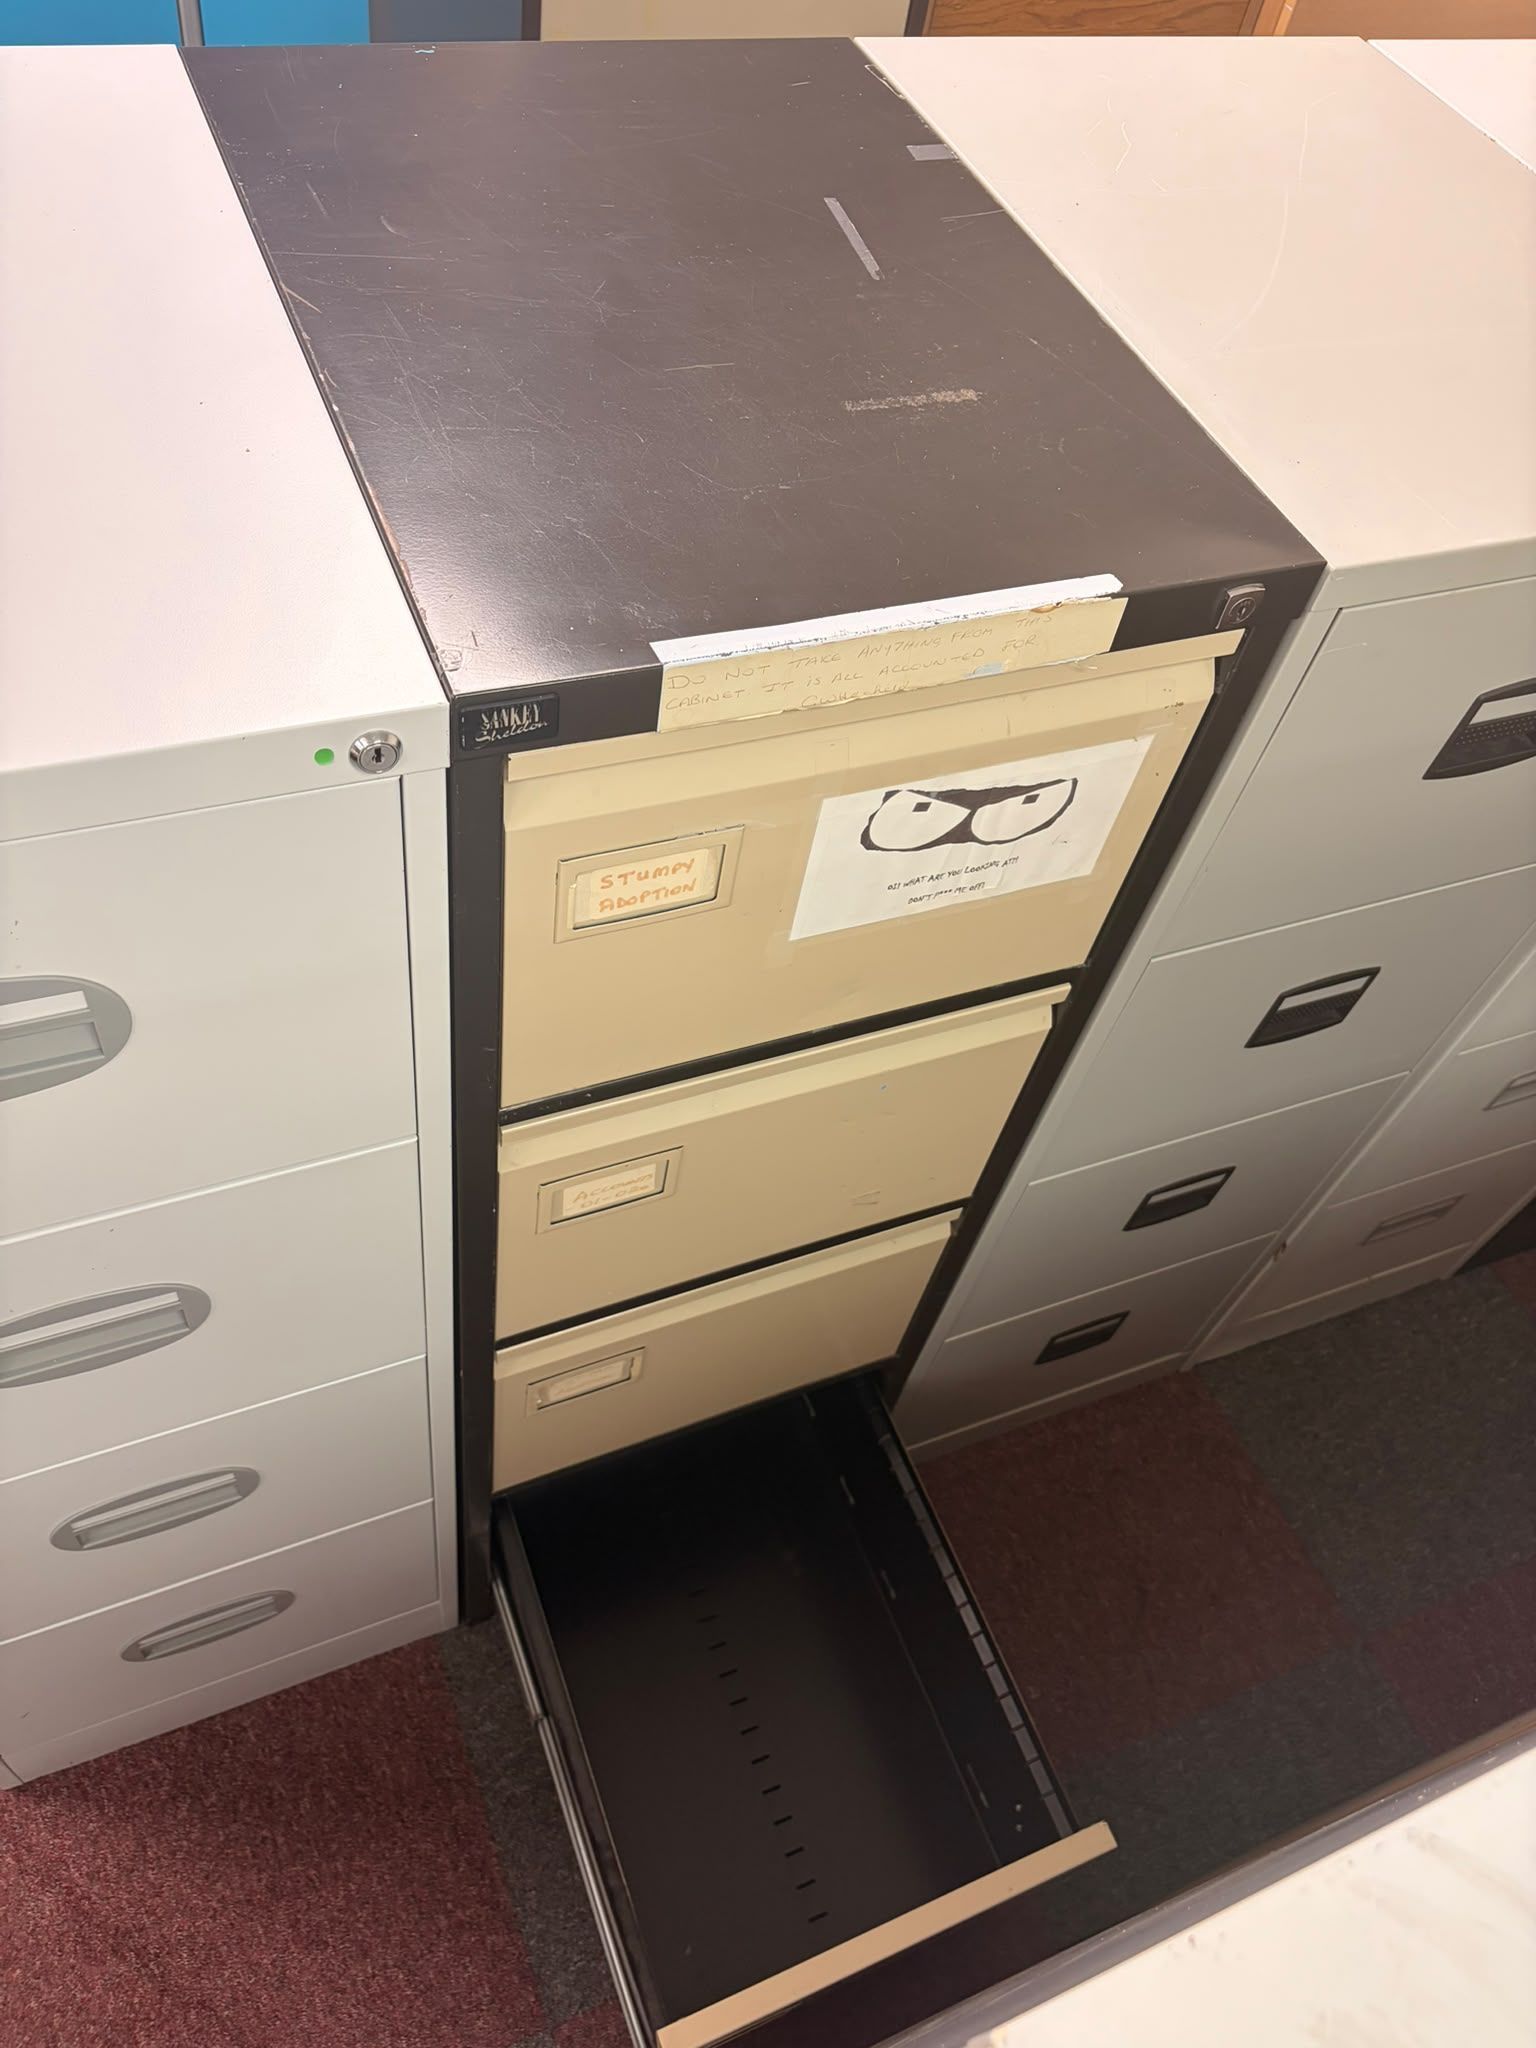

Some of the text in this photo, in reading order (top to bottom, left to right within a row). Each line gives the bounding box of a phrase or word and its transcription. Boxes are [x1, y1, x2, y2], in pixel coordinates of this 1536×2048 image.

[667, 615, 1053, 689] DO NOT TAKE ANYTHING FROM THIS
[831, 671, 864, 684] ALL
[878, 647, 985, 676] ACCOUNTED
[1001, 634, 1037, 652] FOR
[481, 703, 541, 731] SANKEY
[475, 720, 548, 749] Sheldon
[600, 858, 695, 890] STUMPY
[903, 875, 929, 888] WHAT
[927, 872, 946, 883] ARE
[947, 868, 963, 878] YOU
[964, 860, 1001, 874] LOOKING
[599, 878, 697, 913] ADOPTION
